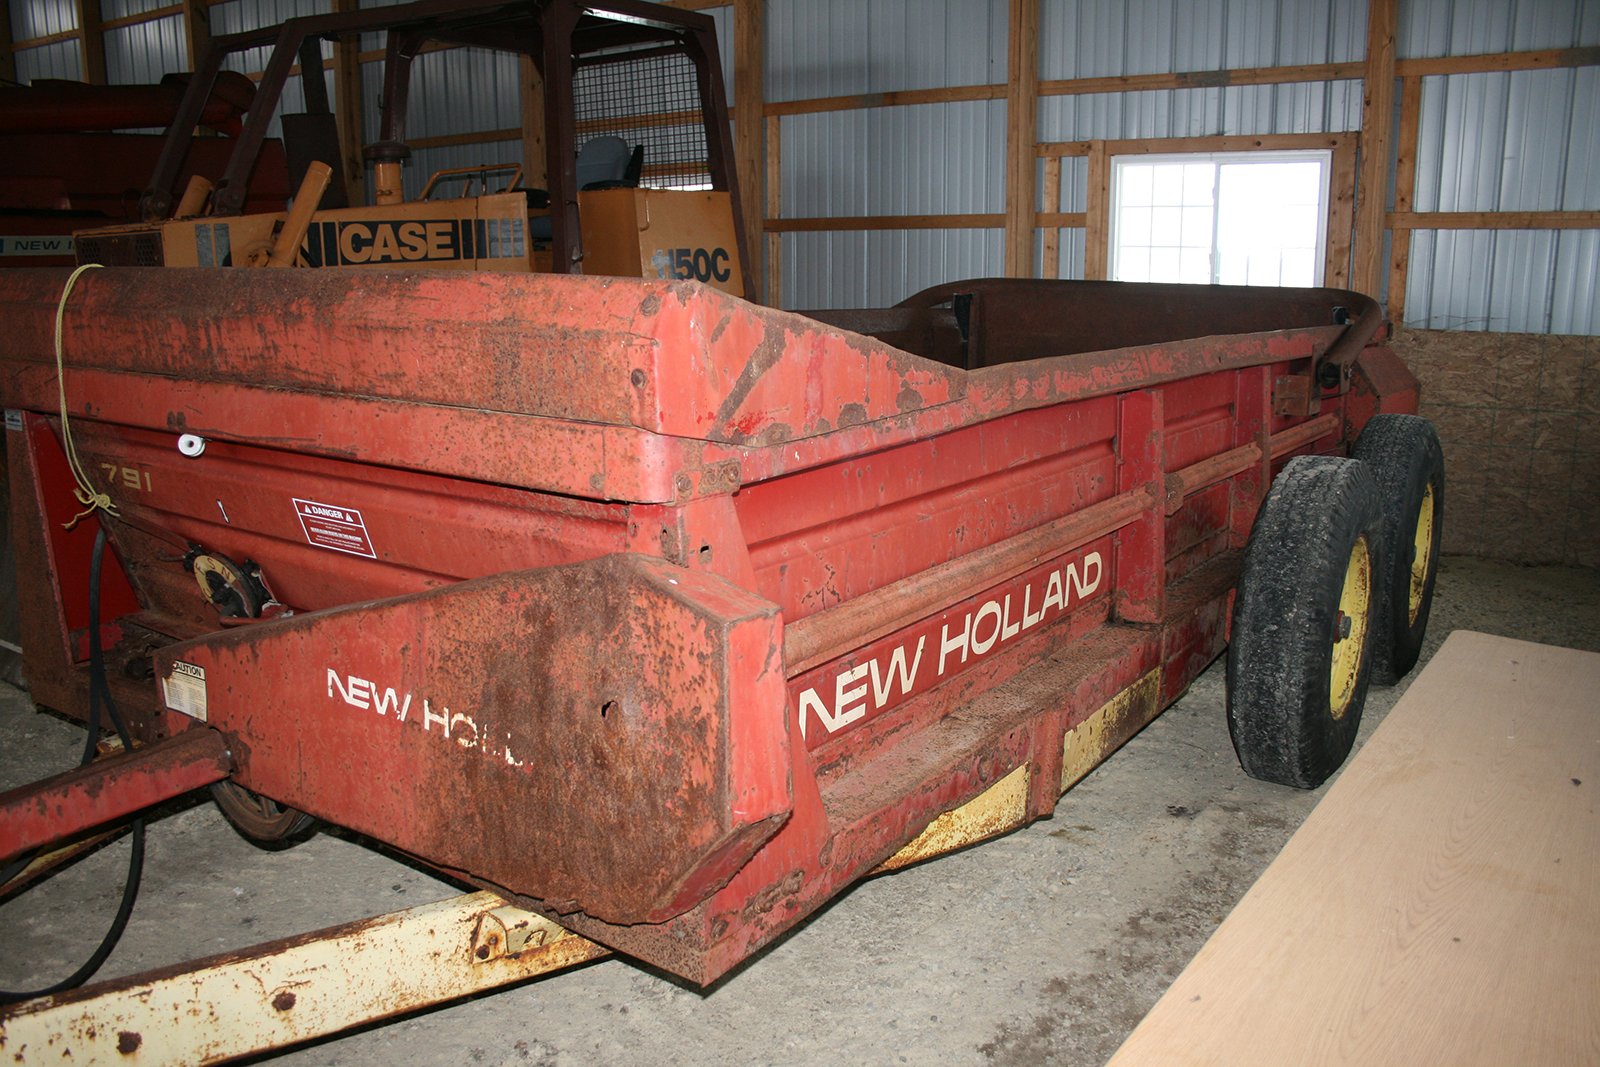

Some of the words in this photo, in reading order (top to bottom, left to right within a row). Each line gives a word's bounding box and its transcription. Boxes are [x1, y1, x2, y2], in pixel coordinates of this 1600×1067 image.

[15, 240, 61, 251] NEW
[340, 222, 455, 264] CASE
[100, 463, 153, 492] 791
[311, 505, 344, 520] DANGER
[799, 635, 926, 742] NEW
[938, 551, 1102, 676] HOLLAND
[327, 668, 412, 722] NEW
